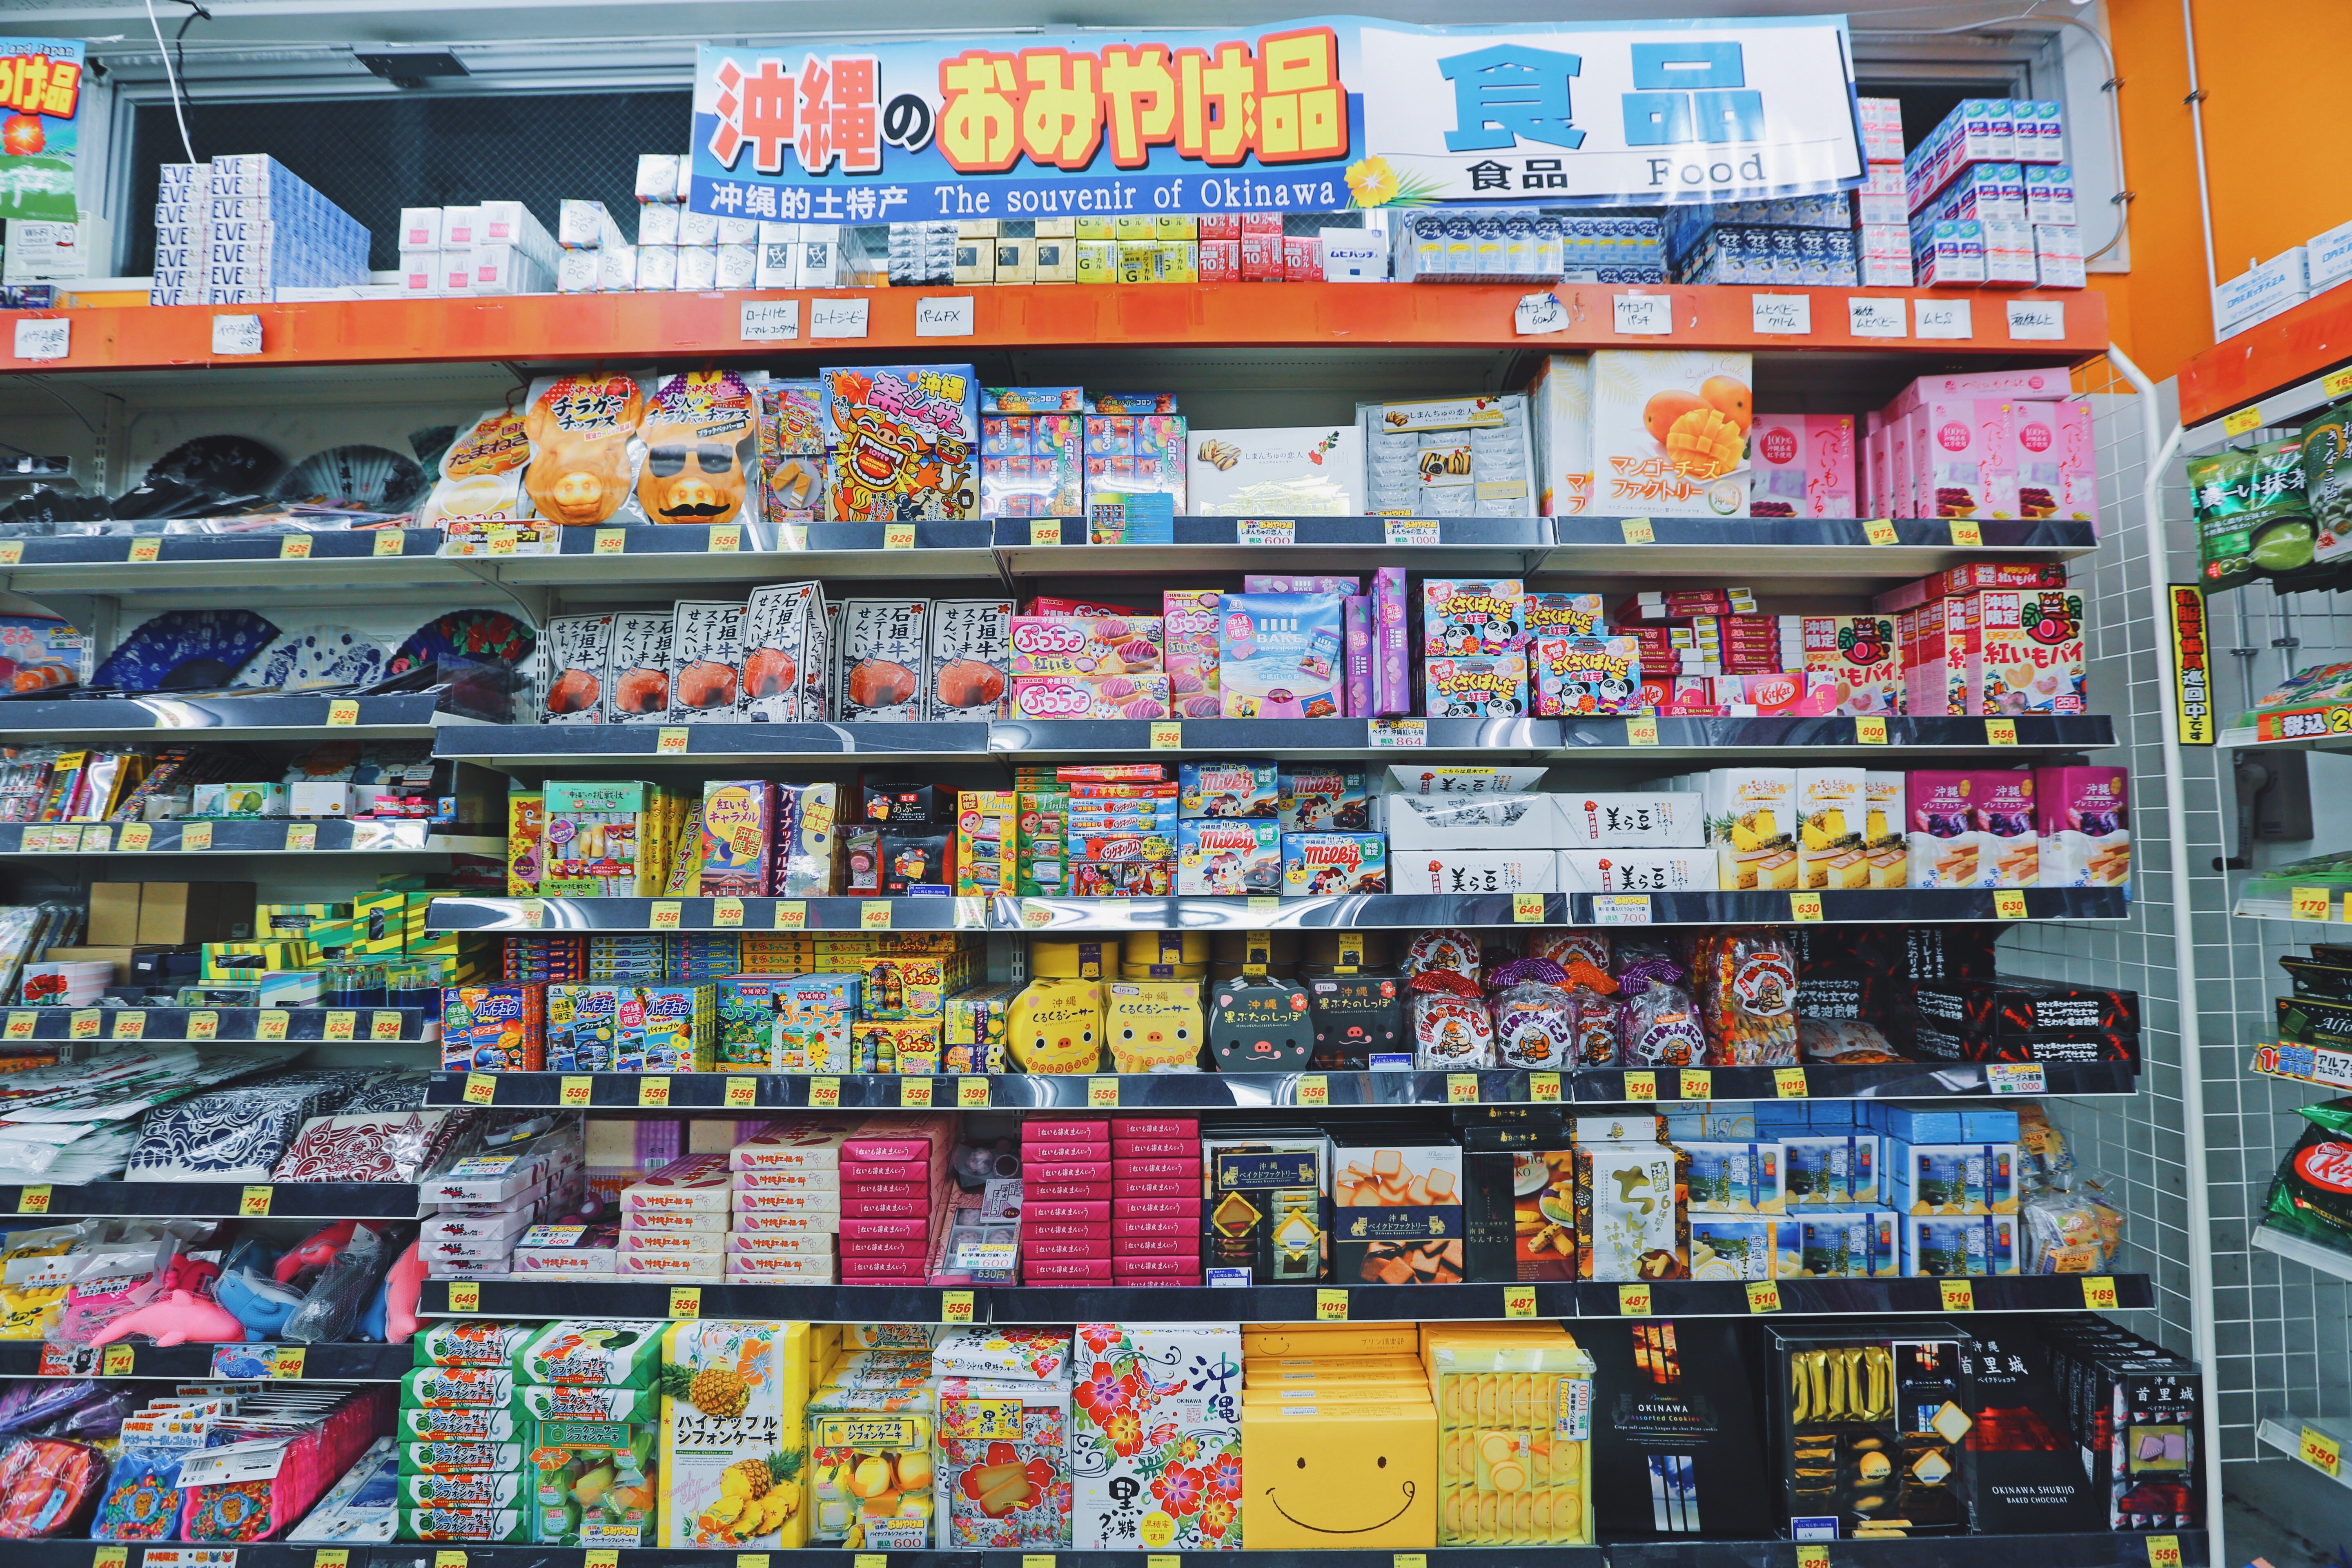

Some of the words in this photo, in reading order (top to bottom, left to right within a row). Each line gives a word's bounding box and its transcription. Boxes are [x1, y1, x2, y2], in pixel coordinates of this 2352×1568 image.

[40, 45, 74, 57] Japan
[1437, 41, 1766, 153] 食品
[214, 159, 243, 174] EVE
[1648, 153, 1766, 186] Food
[163, 167, 194, 183] EVE
[1466, 159, 1568, 191] 食品
[711, 182, 908, 220] 冲绳的土特产
[935, 183, 991, 214] The
[1007, 181, 1136, 214] souvenir
[1154, 178, 1182, 209] of
[1201, 178, 1336, 207] Okinawa
[1201, 259, 1216, 270] 10
[567, 269, 585, 278] PC
[919, 309, 961, 323] パームFX
[1756, 305, 1799, 316] ムヒベビー
[1768, 316, 1795, 327] クリーム
[1924, 312, 1952, 325] ムヒS
[569, 384, 602, 396] 沖縄
[687, 383, 718, 396] 沖縄
[919, 371, 966, 403] 沖縄
[663, 396, 703, 408] 大人の
[1410, 408, 1474, 419] しまんちゅの恋人
[558, 414, 617, 431] チップス
[1245, 450, 1303, 461] しまんちゅの恋人
[1610, 456, 1720, 479] マンゴーチーズ
[1612, 479, 1704, 501] ファクトリー
[1036, 529, 1059, 539] 556
[1628, 528, 1651, 538] 1112
[1873, 528, 1893, 538] 972
[1958, 530, 1979, 539] 584
[381, 539, 401, 550] 741
[493, 539, 514, 550] 500
[890, 534, 913, 544] 926
[1265, 536, 1291, 544] 600
[1410, 535, 1437, 543] 1000
[135, 548, 157, 557] 926
[287, 543, 309, 554] 926
[1436, 597, 1512, 619] さくさくぱんだ
[1985, 594, 2019, 611] 沖縄
[1228, 617, 1249, 628] 沖縄
[1467, 615, 1487, 624] 紅芋
[1985, 610, 2019, 626] 限定
[855, 608, 872, 653] せんべい
[874, 607, 887, 652] ステーキ
[889, 606, 913, 656] 石垣牛
[1230, 627, 1249, 638] 限定
[1806, 621, 1836, 634] 沖縄
[1017, 626, 1082, 650] ぷっちょ
[1256, 633, 1302, 644] BAKE
[1806, 635, 1836, 649] 限定
[1984, 641, 2085, 667] 紅いもパイ
[1033, 657, 1073, 672] 紅いも
[2176, 589, 2203, 741] 私服警備員巡回中です
[1020, 686, 1089, 711] ぷっちょ
[1760, 684, 1794, 704] KitKat
[2283, 715, 2326, 737] 税込
[1633, 728, 1655, 738] 463
[1862, 727, 1884, 737] 800
[1993, 729, 2014, 739] 556
[1380, 737, 1394, 746] 税込
[1396, 737, 1424, 746] 864
[716, 800, 748, 812] 紅いも
[981, 794, 1012, 811] Pinky
[893, 803, 922, 814] あぶー
[708, 811, 760, 824] キャラメル
[1606, 806, 1653, 831] 美ら豆
[125, 834, 148, 844] 369
[1200, 829, 1257, 854] Milky
[1102, 840, 1142, 861] シゲキックス
[1451, 867, 1499, 892] 美ら豆
[1519, 905, 1542, 914] 649
[1798, 904, 1820, 913] 630
[2002, 901, 2023, 911] 630
[2300, 901, 2326, 911] 170
[780, 912, 803, 921] 556
[866, 912, 889, 921] 463
[797, 992, 826, 1000] 沖縄限定
[474, 999, 524, 1019] ハイチュウ
[1033, 1009, 1094, 1023] くるくるシーサー
[1224, 1011, 1302, 1024] 黒ぶたのしっぽ
[118, 1022, 142, 1031] 556
[192, 1022, 215, 1032] 741
[263, 1022, 285, 1031] 741
[329, 1023, 353, 1032] 834
[471, 1024, 503, 1035] マンゴー味
[1453, 1085, 1477, 1095] 510
[1536, 1084, 1559, 1094] 510
[1780, 1080, 1805, 1090] 1019
[644, 1088, 667, 1098] 556
[906, 1089, 930, 1099] 556
[964, 1089, 987, 1099] 399
[858, 1146, 909, 1159] 紅いも薄皮まんじゅう
[477, 1166, 503, 1174] 700
[1239, 1170, 1298, 1180] ベイクドファクトリー
[25, 1195, 48, 1205] 556
[549, 1237, 570, 1245] 600
[978, 1270, 1006, 1281] 630円
[454, 1294, 477, 1304] 649
[1625, 1296, 1649, 1306] 487
[2091, 1290, 2114, 1301] 189
[448, 1348, 501, 1358] シフォンケーキ
[47, 1356, 74, 1365] アグー豚
[1960, 1356, 2028, 1376] 首里城
[548, 1365, 606, 1376] シフォンケーキ
[1637, 1404, 1688, 1413] OKINAWA
[124, 1421, 154, 1432] 沖縄限定
[677, 1416, 778, 1429] パイナップル
[2307, 1444, 2336, 1464] 350
[1108, 1477, 1143, 1539] 黒糖
[1144, 1519, 1169, 1528] 黒糖蜜
[1149, 1532, 1165, 1541] 使用
[2155, 1550, 2178, 1560] 556
